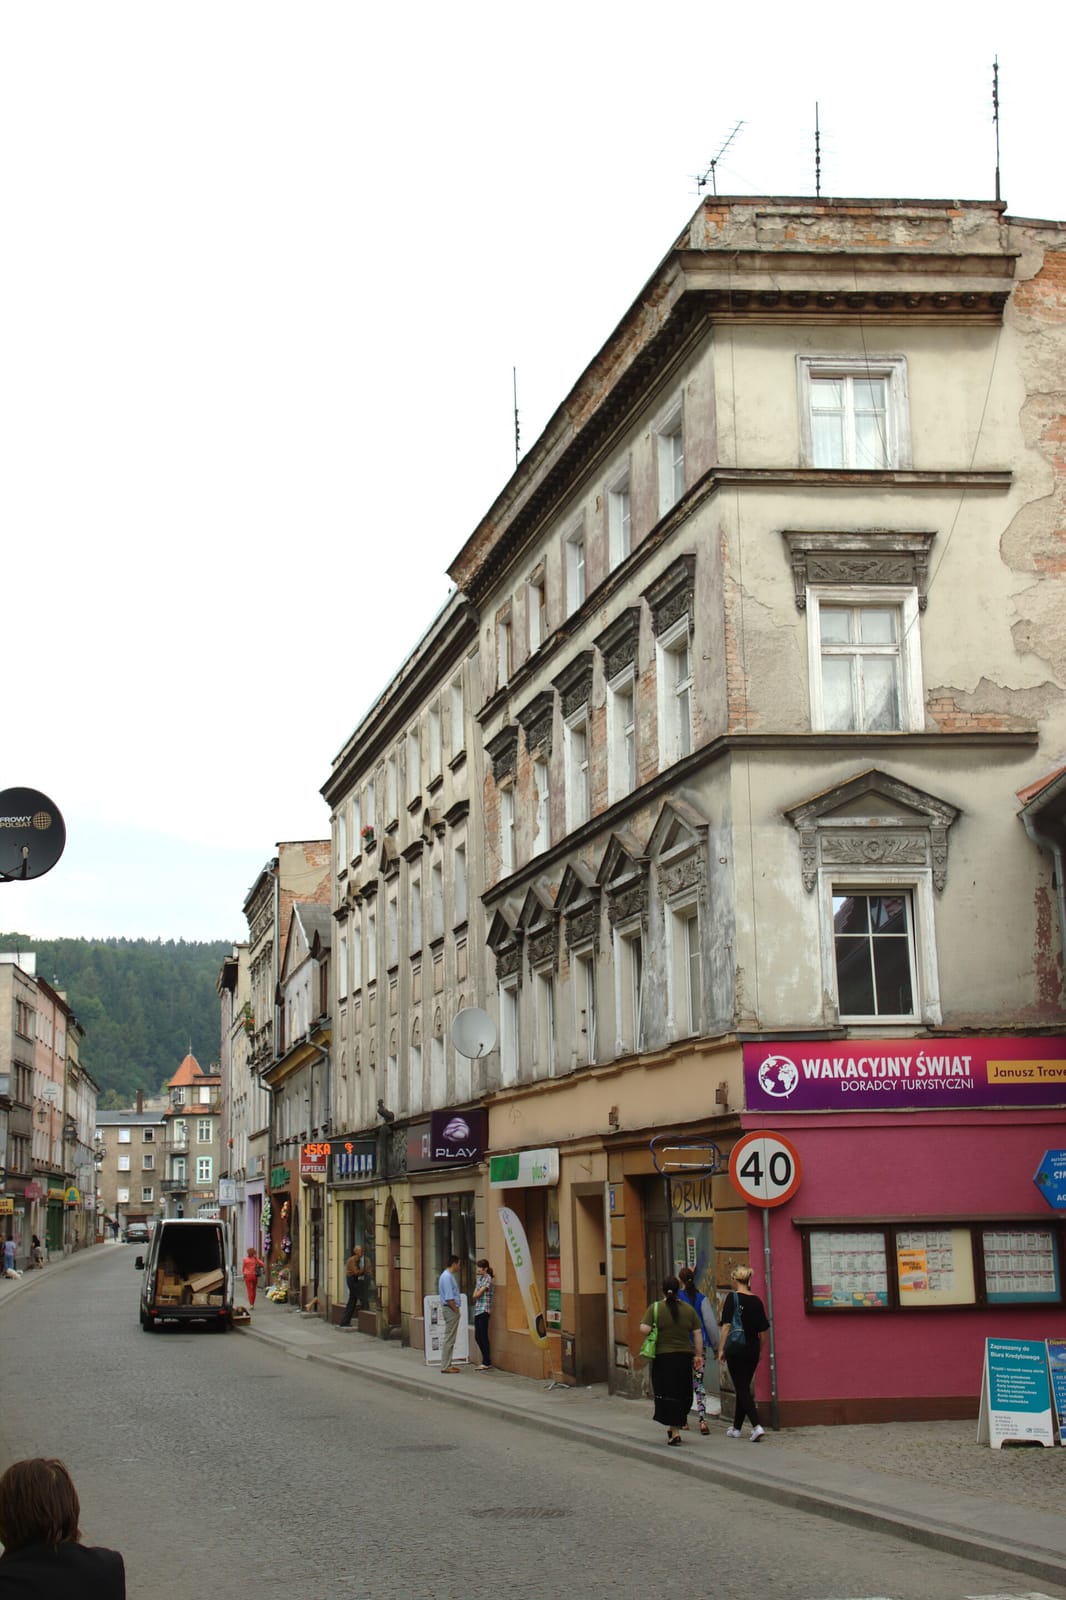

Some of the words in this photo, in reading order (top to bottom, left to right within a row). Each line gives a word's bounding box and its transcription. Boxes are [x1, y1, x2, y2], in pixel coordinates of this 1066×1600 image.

[801, 1056, 911, 1079] WAKACYJNY
[916, 1051, 971, 1076] ŚWIAT
[993, 1066, 1034, 1078] Janusz
[841, 1080, 897, 1092] DORADCY
[901, 1078, 974, 1091] TURYSTYCZNI
[435, 1148, 477, 1158] PLAY
[740, 1151, 791, 1187] 40
